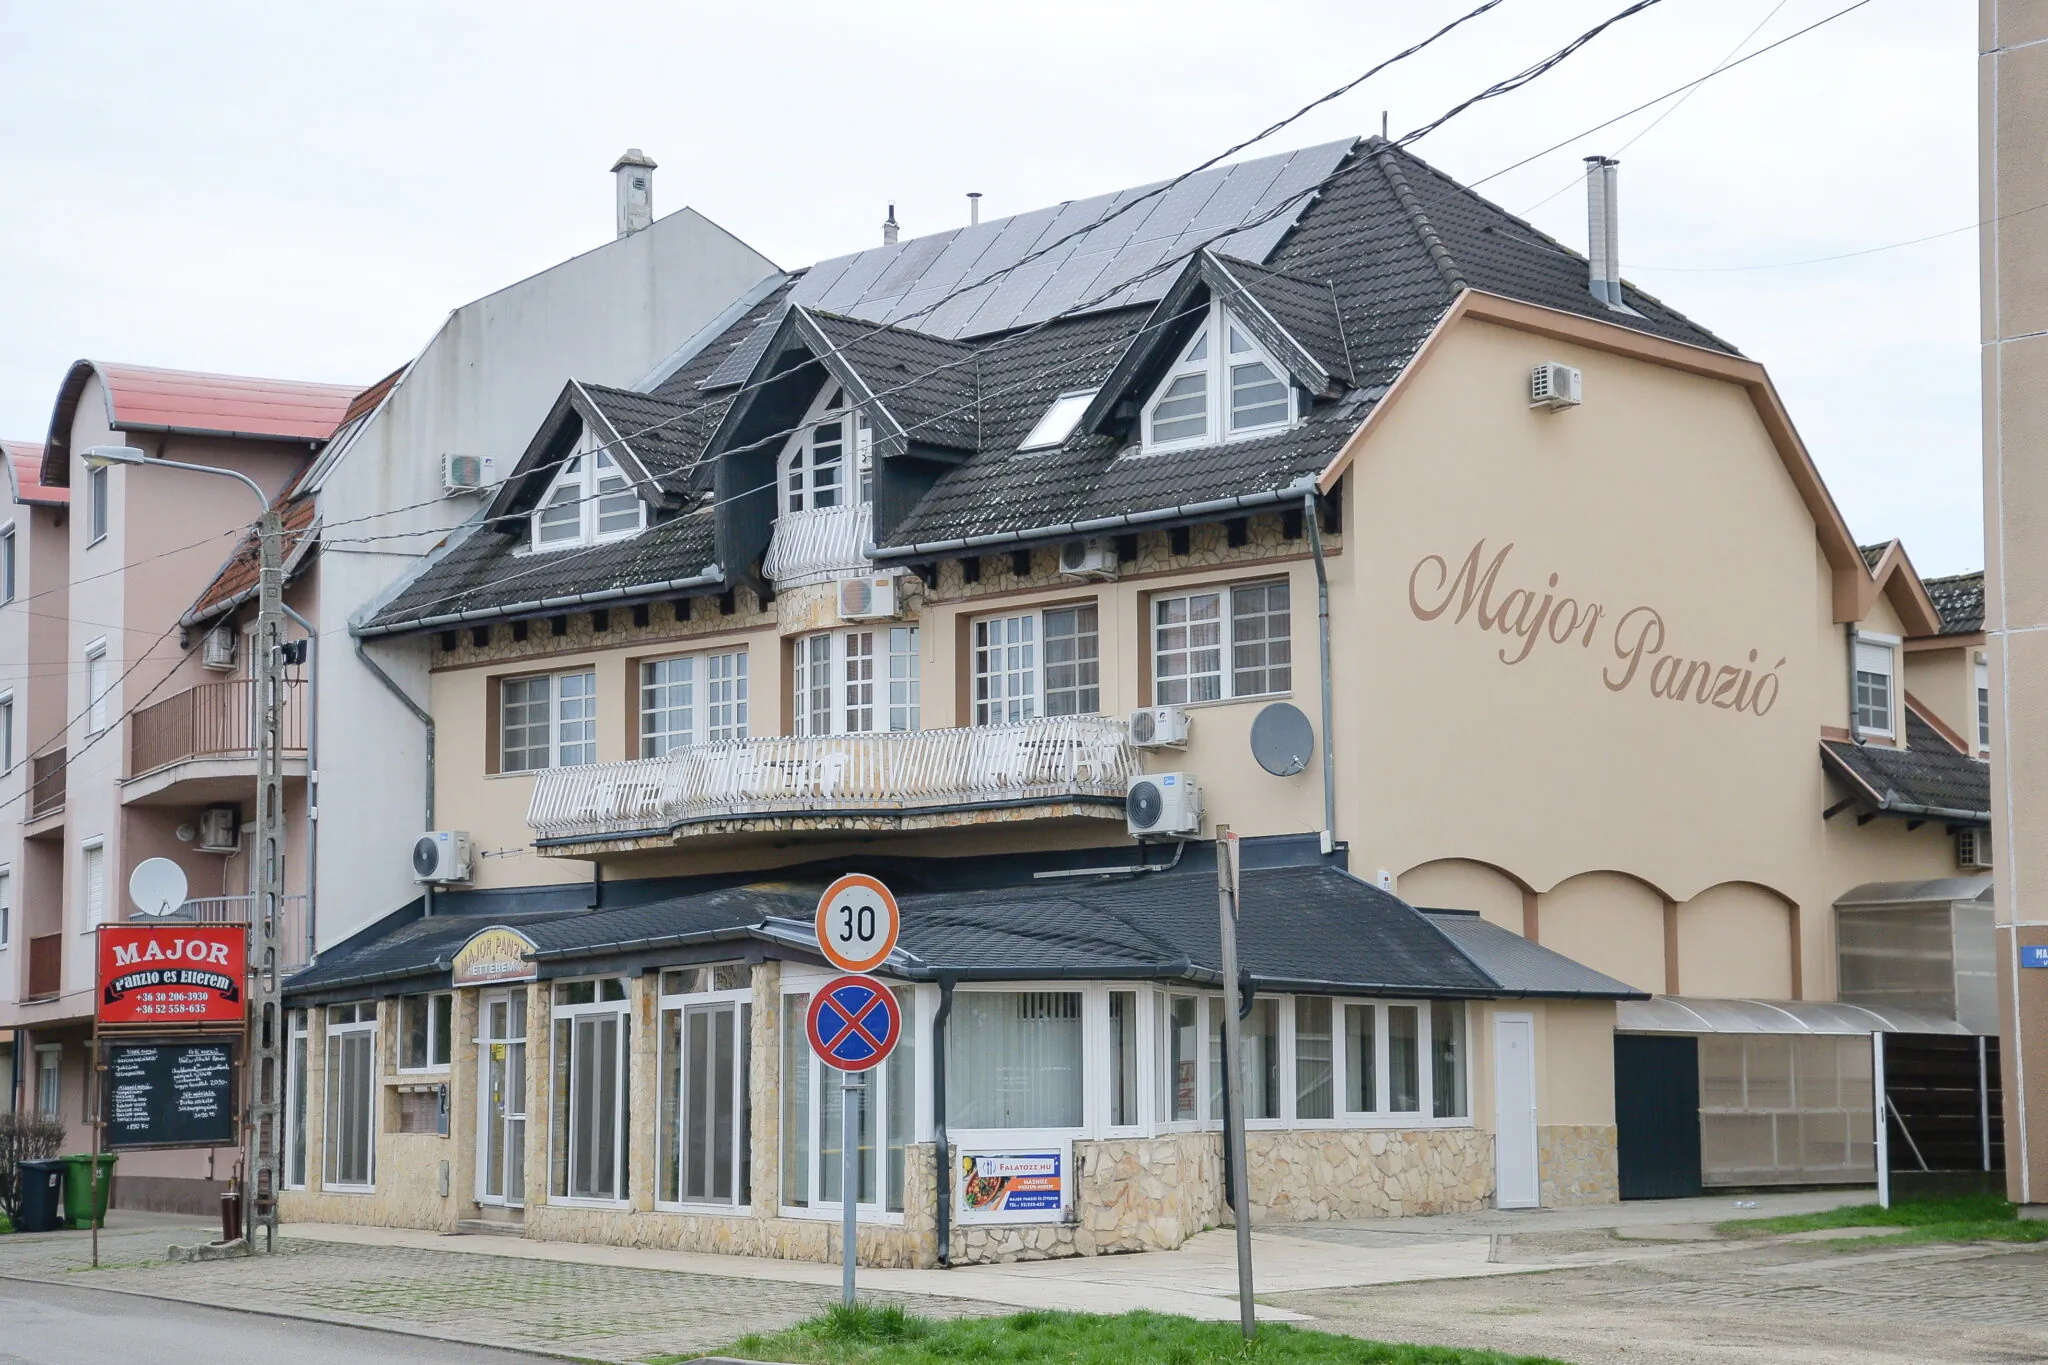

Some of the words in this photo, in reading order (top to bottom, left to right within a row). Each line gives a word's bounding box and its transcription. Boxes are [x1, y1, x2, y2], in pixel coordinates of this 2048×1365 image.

[1409, 538, 1606, 665] Major
[1603, 606, 1786, 716] Panzió
[839, 905, 875, 942] 30
[112, 939, 229, 966] MAJOR
[461, 939, 492, 976] MAJOR
[136, 992, 153, 1002] +36
[155, 992, 166, 1002] 30
[168, 991, 208, 1001] 206-3930
[136, 1004, 153, 1014] +36
[155, 1004, 166, 1013] 52
[168, 1003, 206, 1013] 558-635
